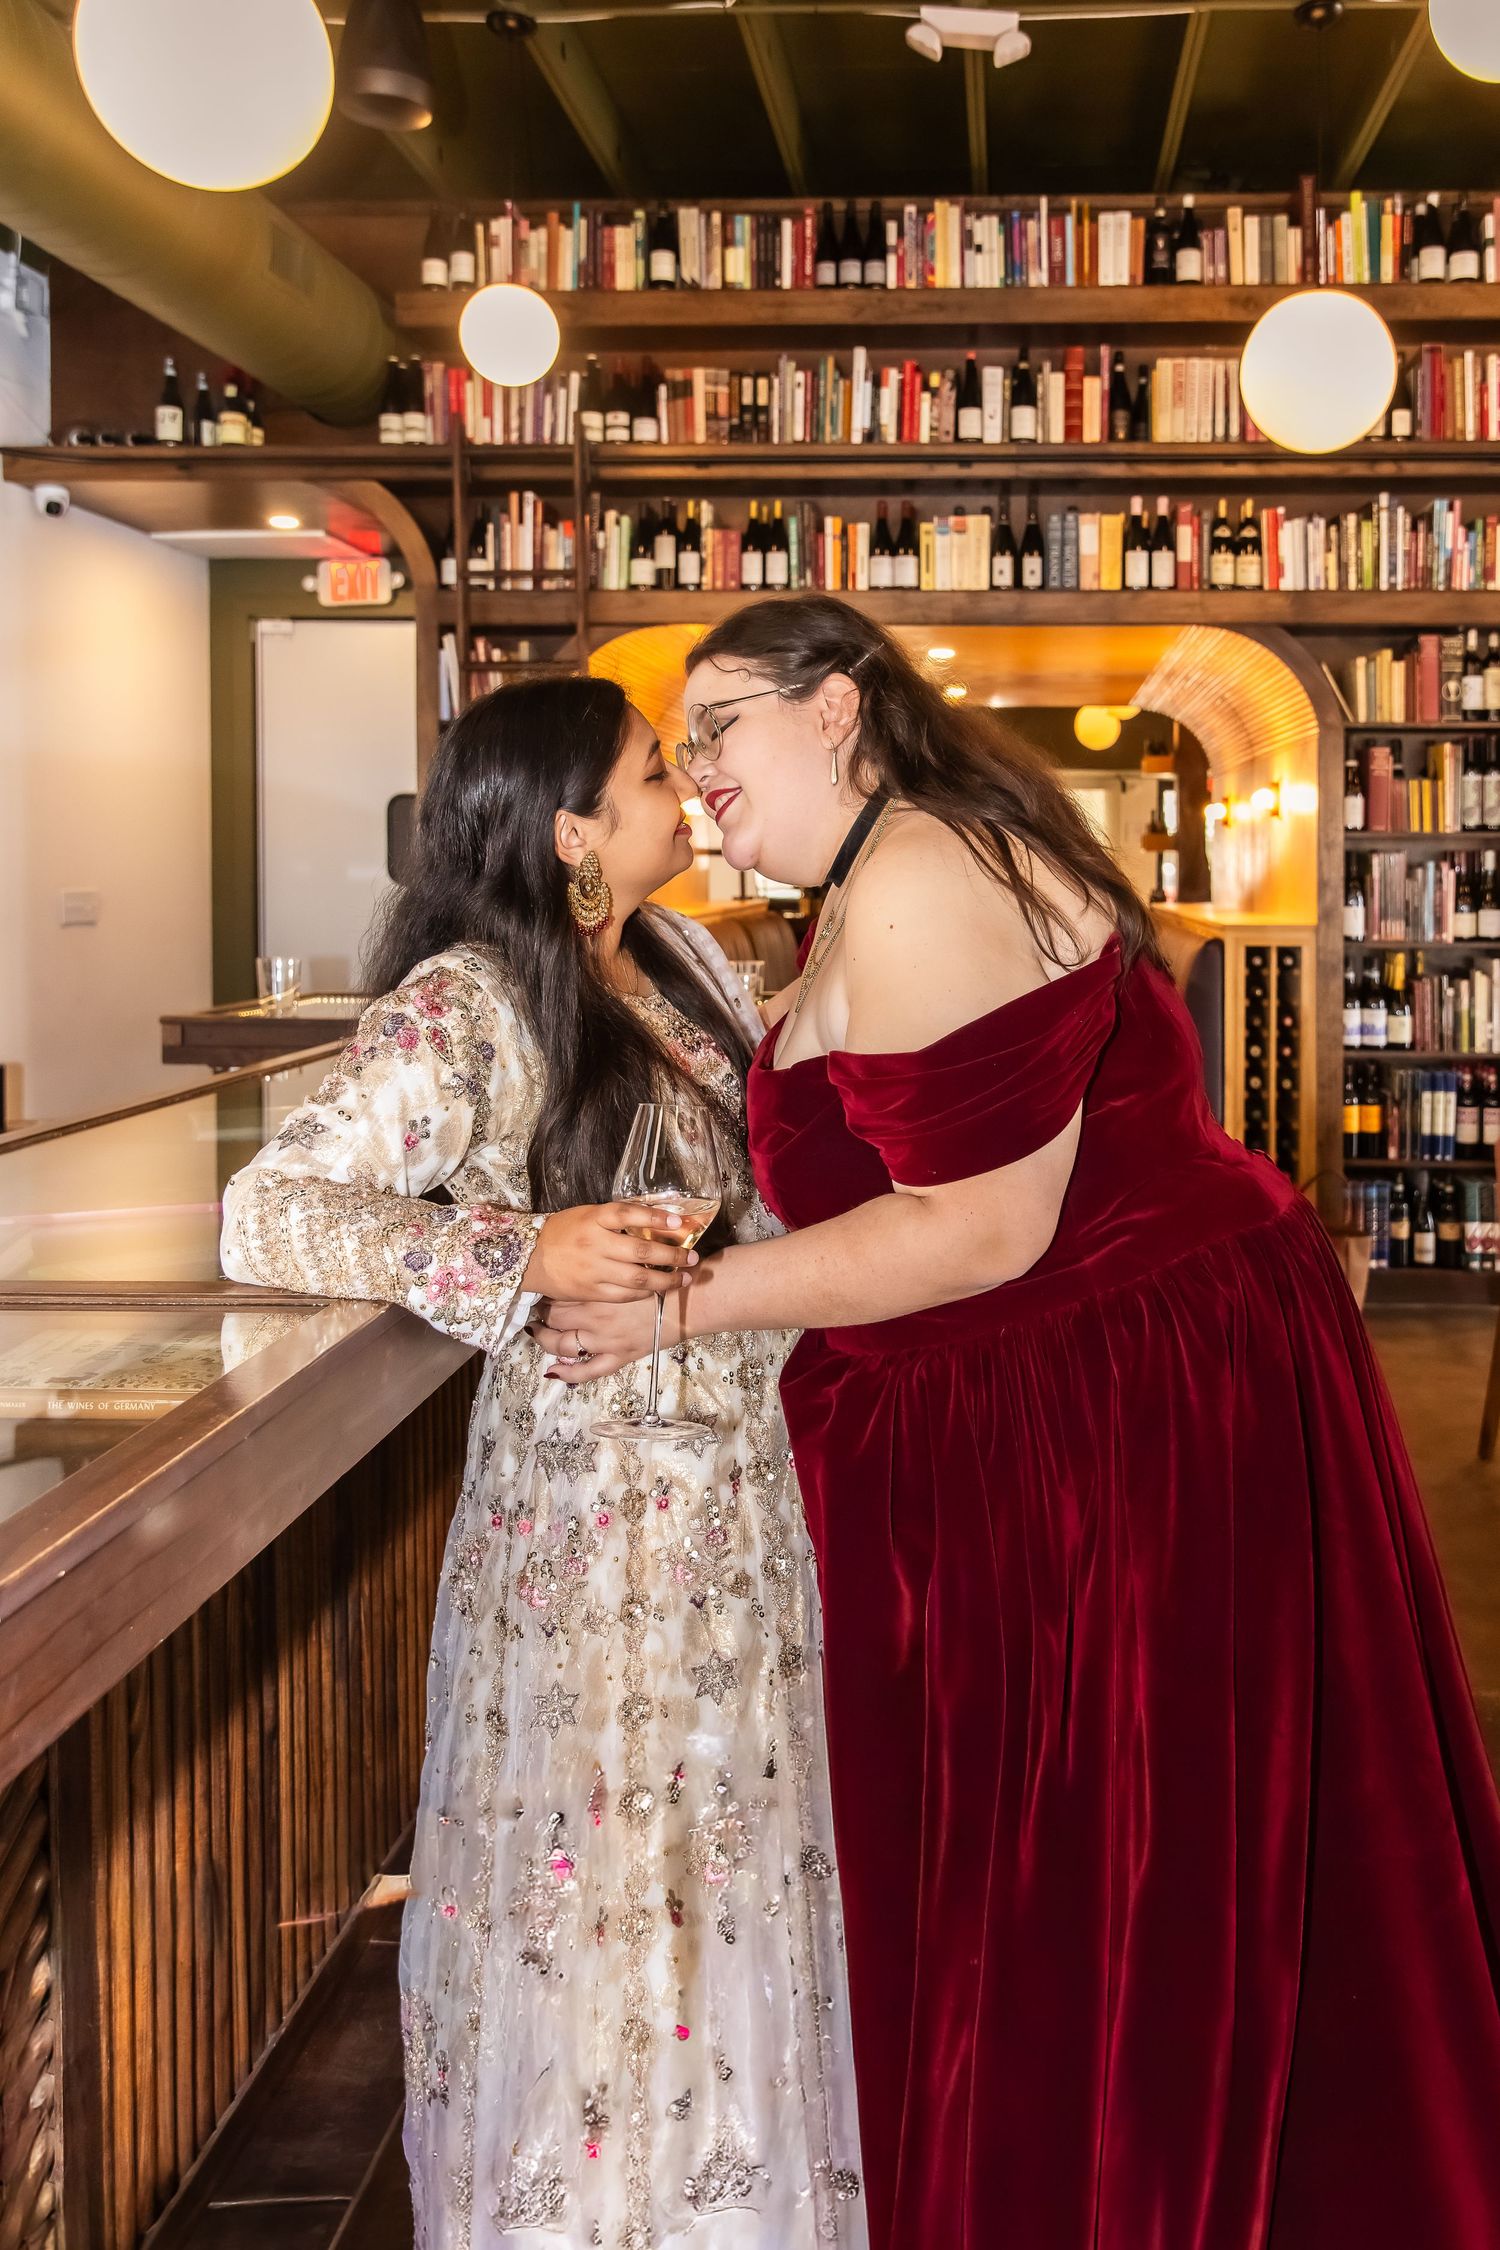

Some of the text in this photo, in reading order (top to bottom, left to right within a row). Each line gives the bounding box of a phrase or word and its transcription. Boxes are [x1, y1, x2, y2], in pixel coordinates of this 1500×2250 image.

[330, 561, 380, 601] EXIT
[48, 1401, 63, 1410] THE
[67, 1401, 94, 1410] WINES
[98, 1402, 108, 1410] OF
[113, 1401, 156, 1411] GERMANY
